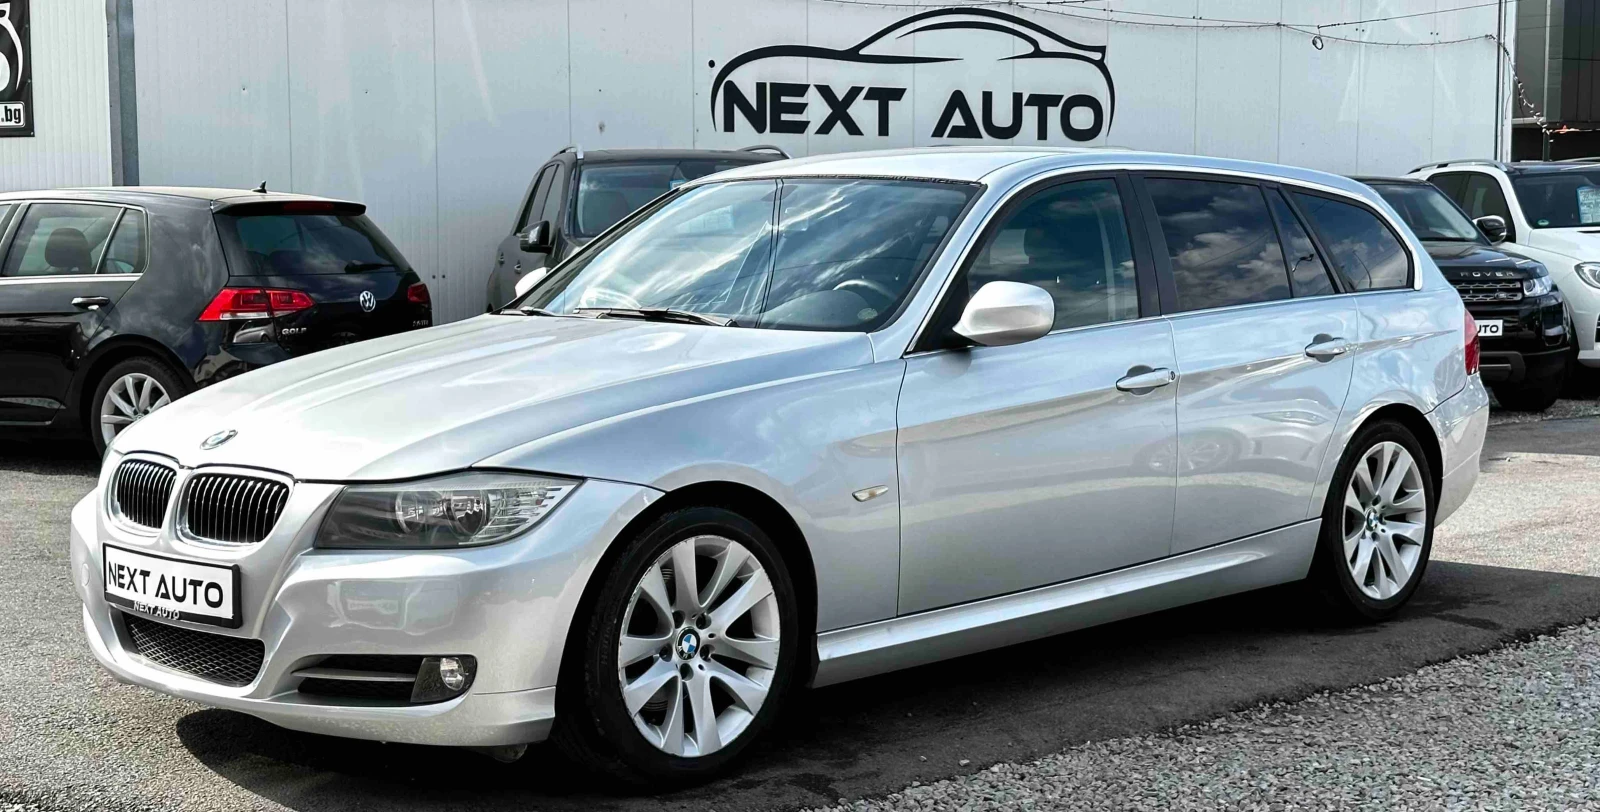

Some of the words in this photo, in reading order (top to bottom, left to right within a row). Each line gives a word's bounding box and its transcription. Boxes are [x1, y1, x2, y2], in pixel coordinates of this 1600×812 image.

[723, 79, 907, 137] NEXT
[931, 89, 1102, 141] AUTO
[282, 327, 307, 335] GOLF
[108, 561, 151, 595] NEXT
[155, 573, 223, 609] AUTO
[133, 600, 155, 615] NEXT
[154, 606, 180, 620] AUTO
